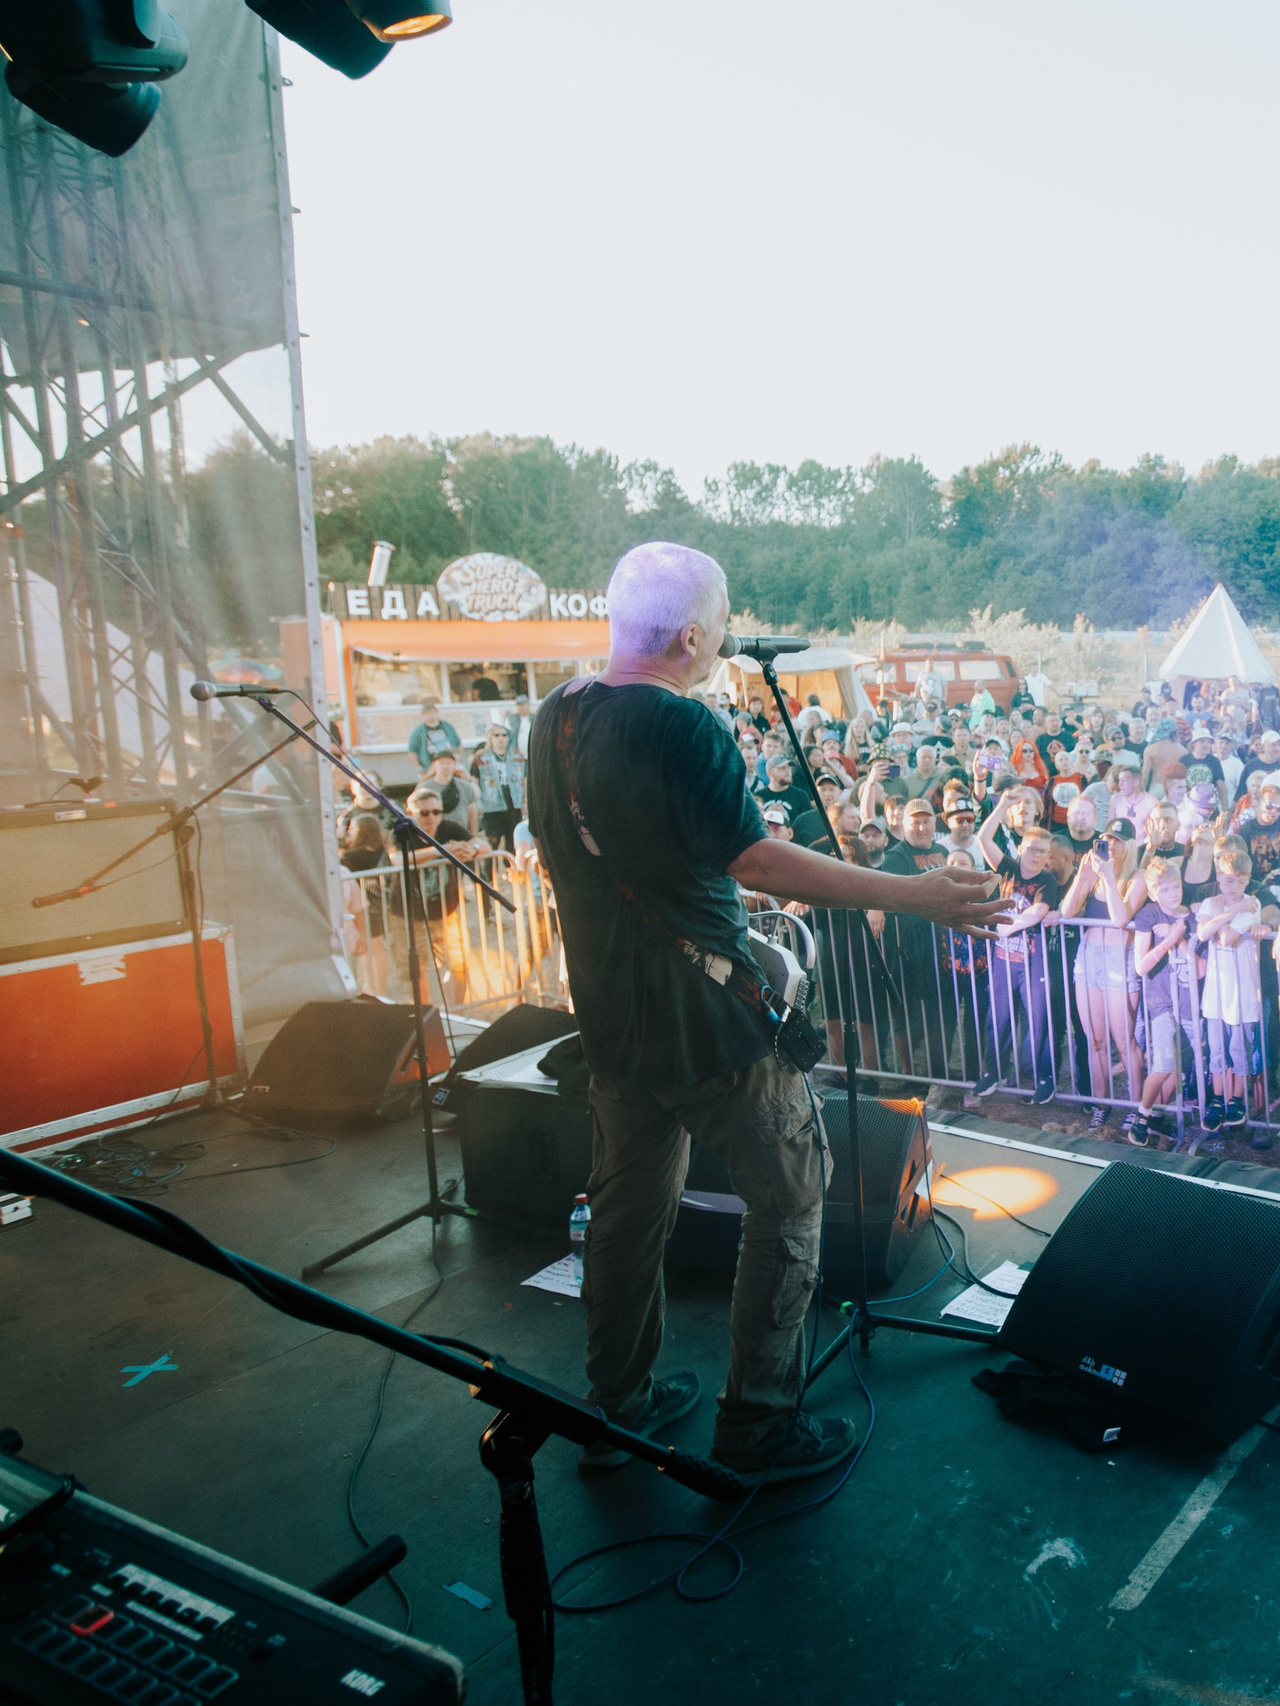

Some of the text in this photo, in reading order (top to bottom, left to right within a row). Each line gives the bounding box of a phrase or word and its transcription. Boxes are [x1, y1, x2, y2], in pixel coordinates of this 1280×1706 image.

[461, 562, 518, 583] SUPER
[470, 578, 515, 595] HERO
[347, 590, 440, 620] ЕДА
[467, 593, 521, 615] TRUCK
[550, 593, 609, 618] КОФ
[341, 1669, 385, 1696] KORG
